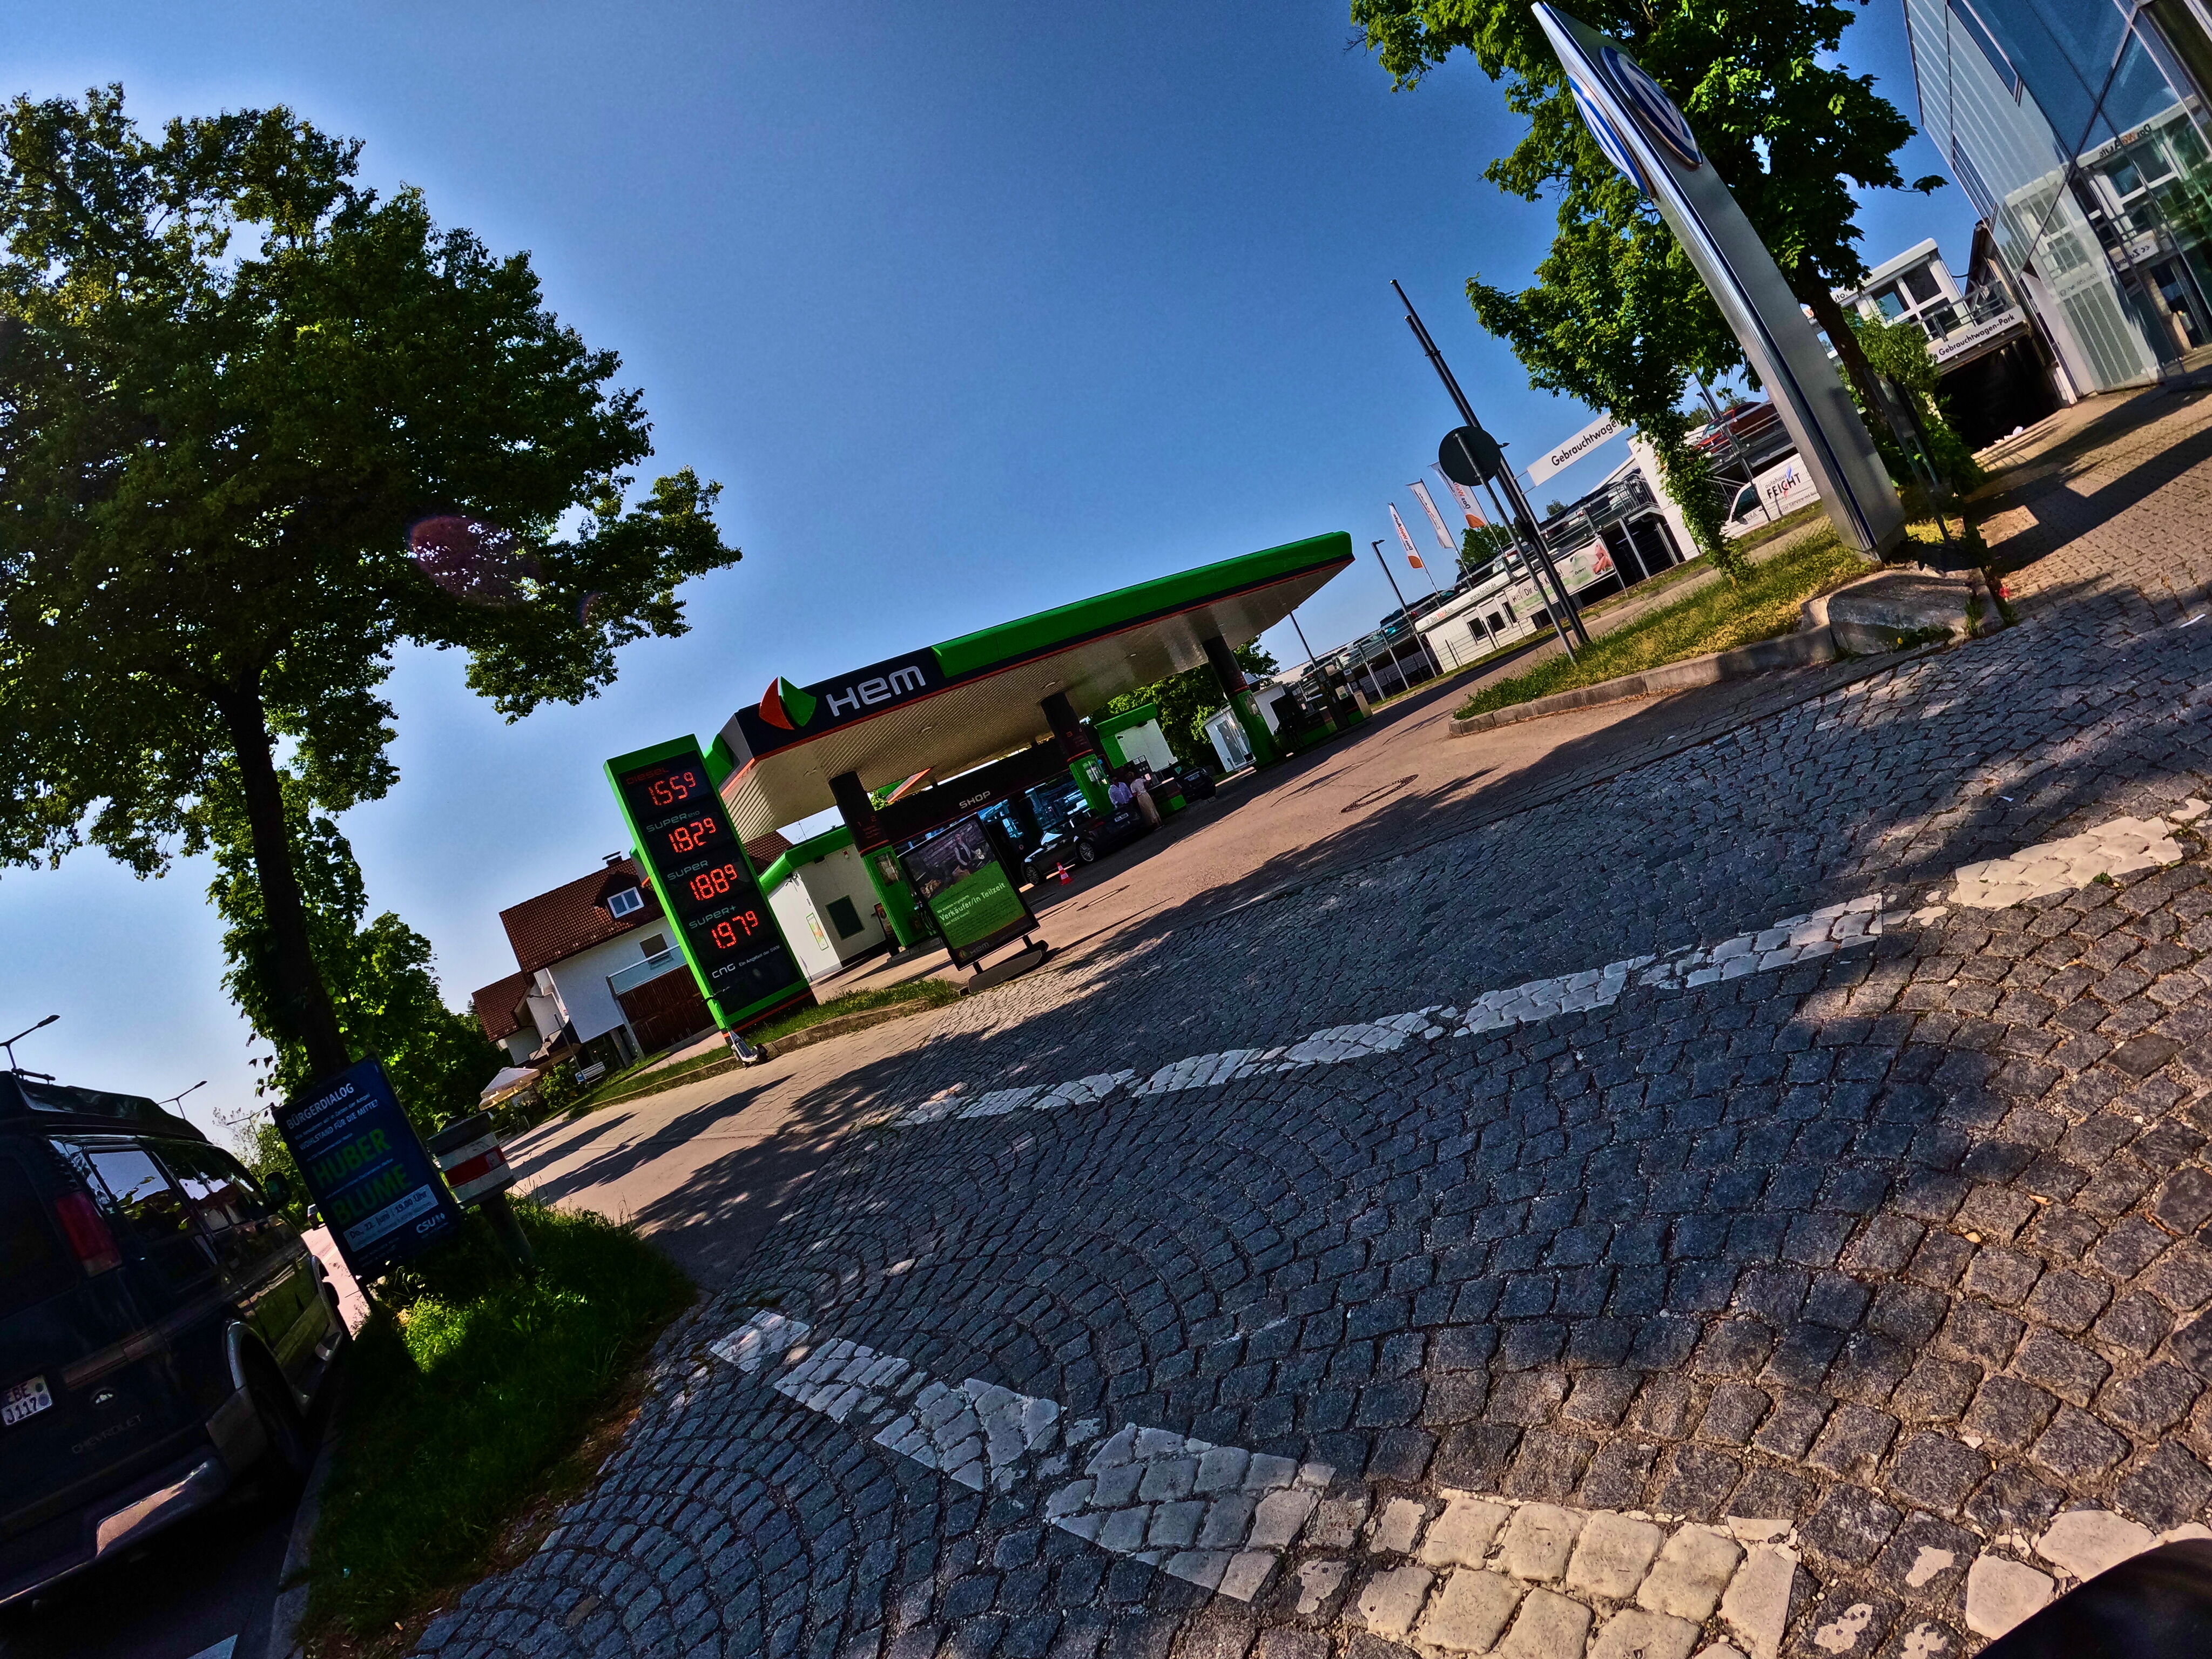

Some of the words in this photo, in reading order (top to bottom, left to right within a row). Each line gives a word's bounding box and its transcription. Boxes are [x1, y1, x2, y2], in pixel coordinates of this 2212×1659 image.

[1939, 313, 2015, 355] Gebrauchtwagen-Park
[1767, 473, 1800, 498] FEICHT
[1469, 583, 1496, 601] www.feicht.de
[1523, 587, 1533, 596] Dir
[959, 791, 991, 809] SHOP
[646, 813, 687, 832] SUPER
[667, 860, 709, 881] SUPER
[981, 882, 1006, 899] Teilzeit
[689, 905, 737, 929] SUPER+
[746, 953, 763, 963] Angebot
[286, 1083, 354, 1130] BÜRGERDIALOG
[334, 1118, 346, 1130] FÜR
[346, 1112, 358, 1123] DIE
[311, 1128, 392, 1188] HUBER
[329, 1163, 413, 1225] BLUME
[375, 1210, 390, 1226] Juni
[413, 1191, 427, 1202] Uhr
[416, 1217, 436, 1233] CSU
[5, 1381, 31, 1404] EBE
[71, 1413, 142, 1454] CHEVROLET
